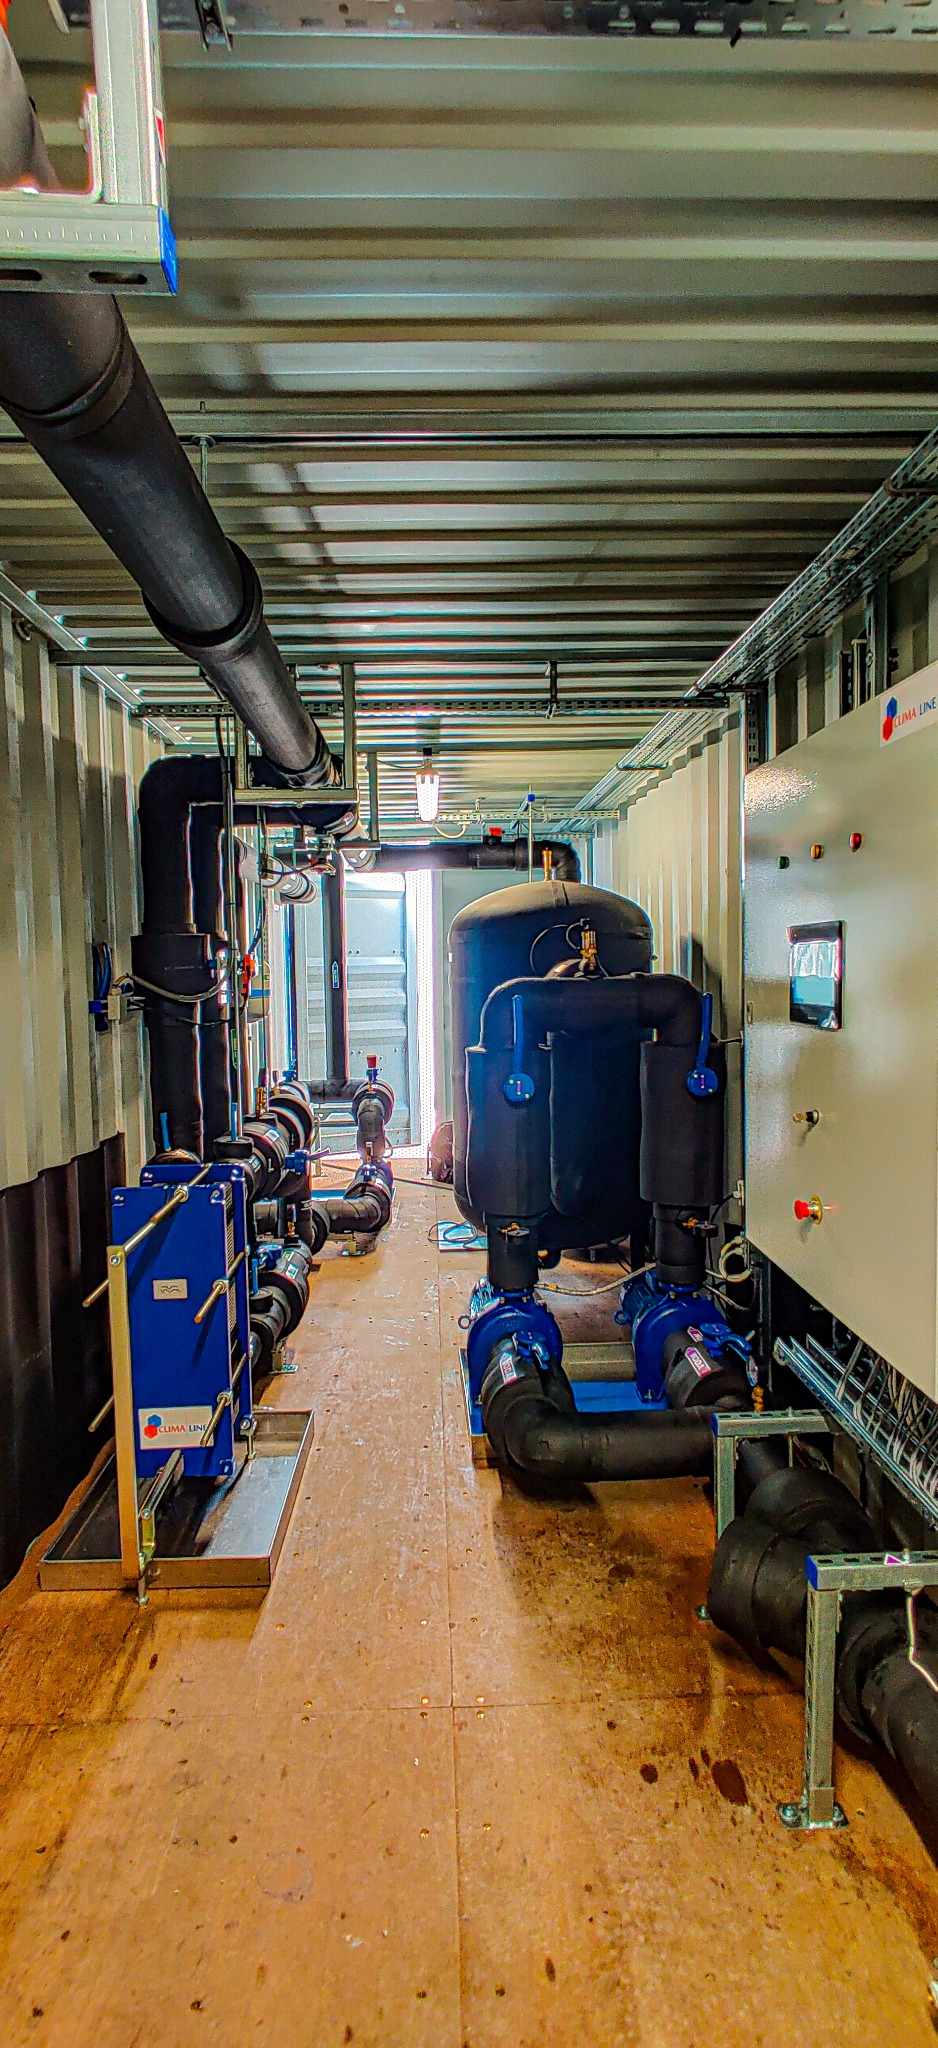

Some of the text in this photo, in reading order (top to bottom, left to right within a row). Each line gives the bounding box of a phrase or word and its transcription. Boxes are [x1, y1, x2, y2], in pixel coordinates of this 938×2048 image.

[894, 696, 937, 728] CLIMA LINE
[158, 1425, 186, 1433] CLIMA
